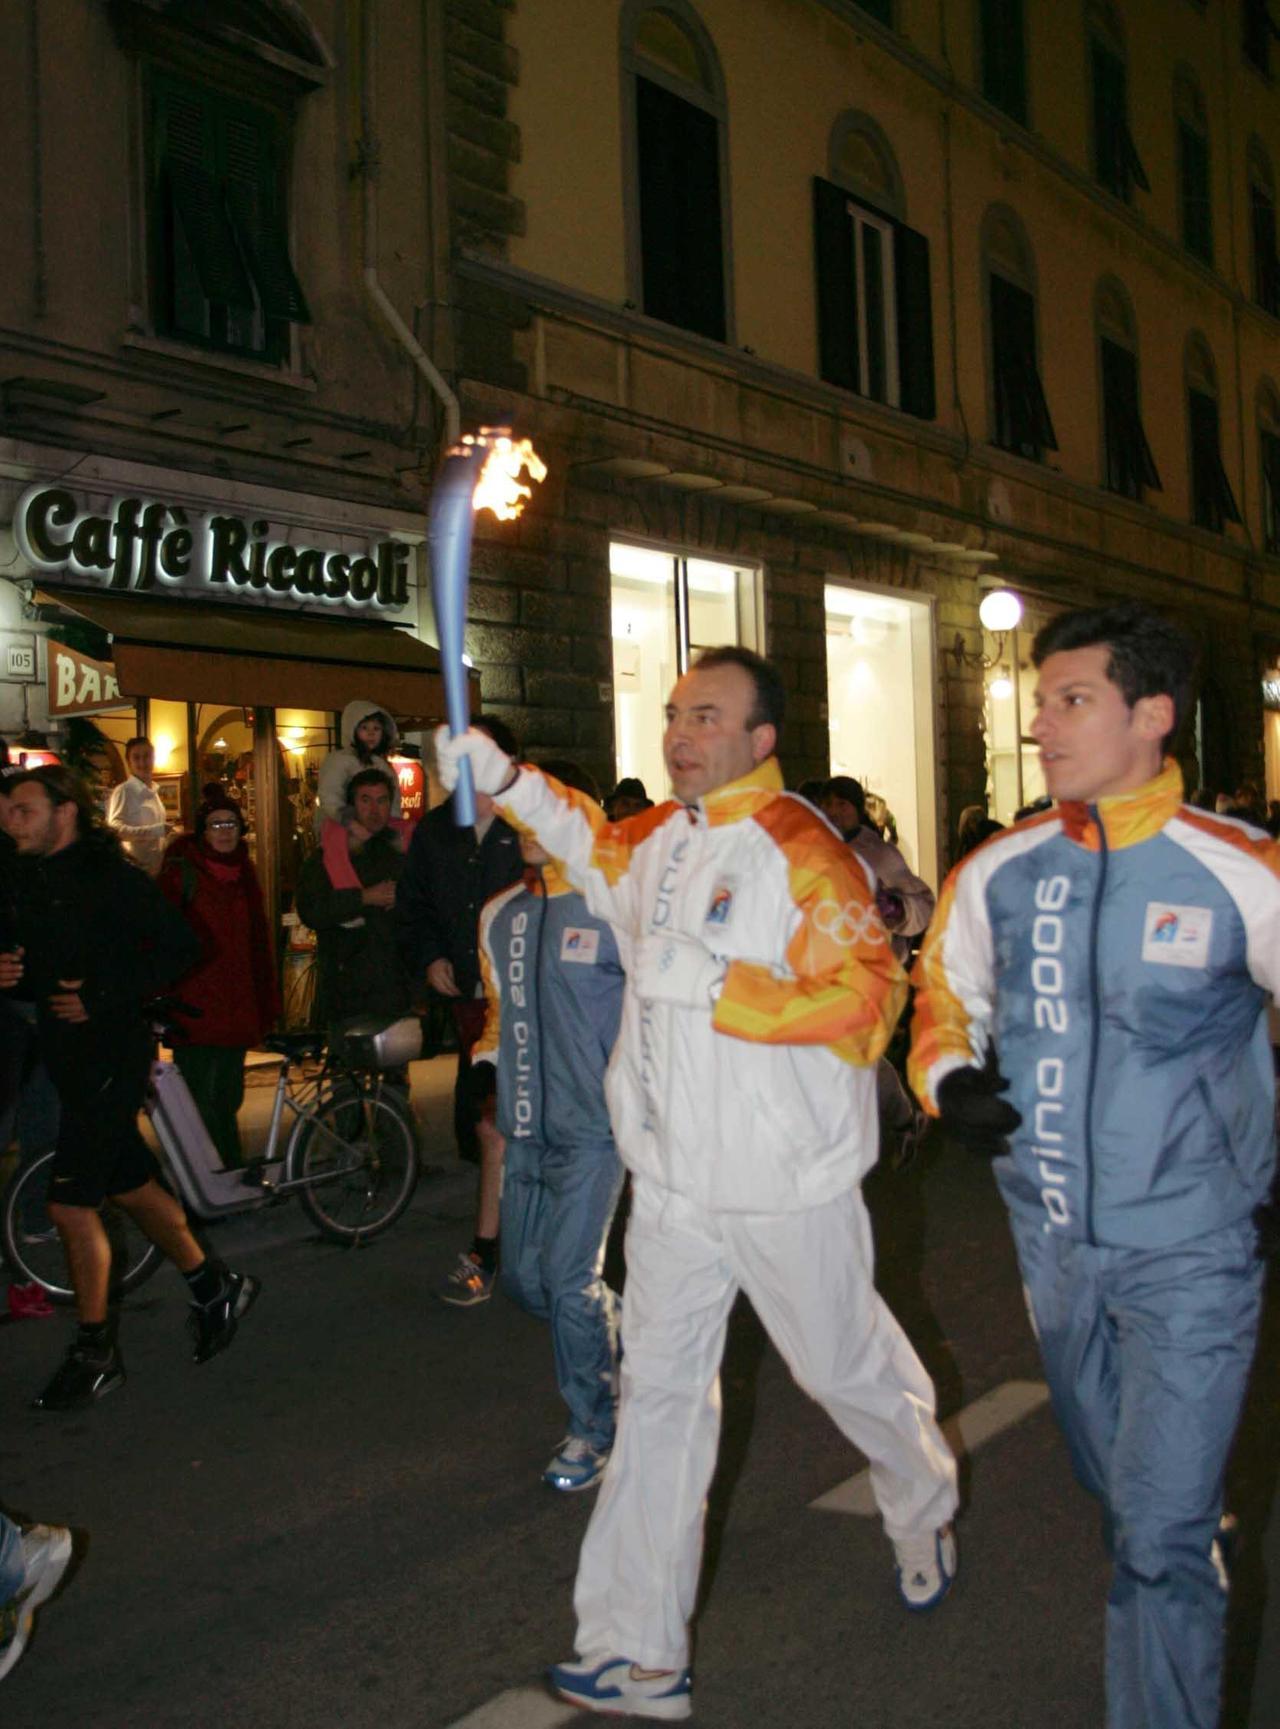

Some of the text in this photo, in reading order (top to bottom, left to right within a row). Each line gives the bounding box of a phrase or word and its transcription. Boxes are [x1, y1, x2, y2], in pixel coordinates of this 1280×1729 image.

[24, 488, 411, 605] Caffè Ricasoli
[11, 652, 31, 668] 105
[55, 652, 125, 707] BAR
[1031, 874, 1072, 1034] 2006
[508, 911, 532, 1139] torino 2006
